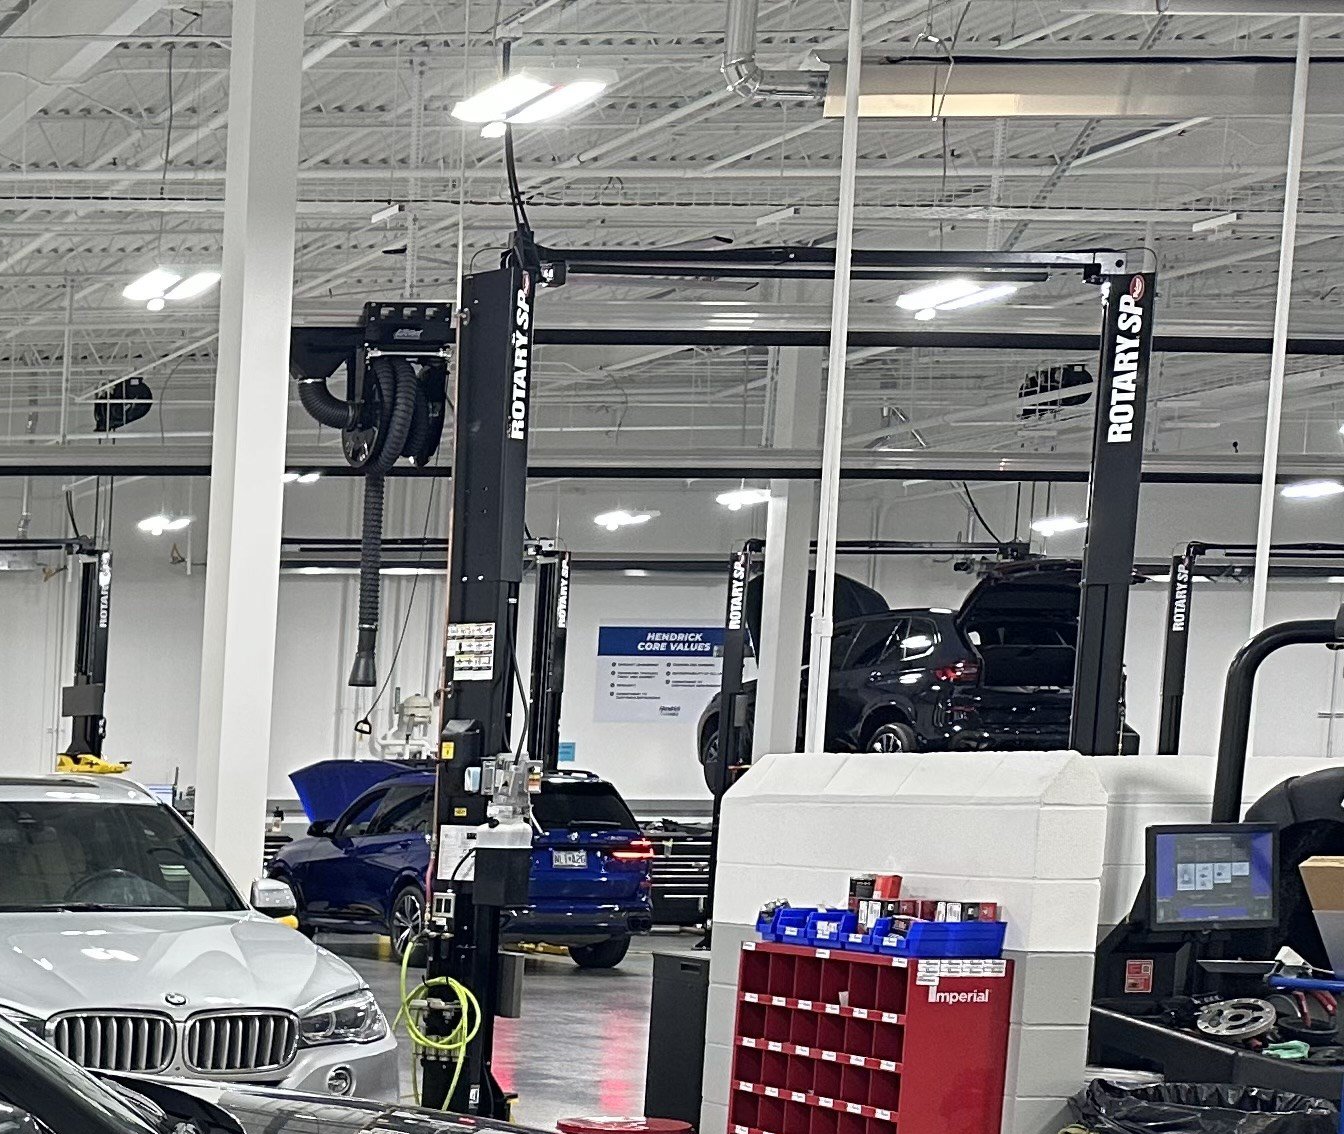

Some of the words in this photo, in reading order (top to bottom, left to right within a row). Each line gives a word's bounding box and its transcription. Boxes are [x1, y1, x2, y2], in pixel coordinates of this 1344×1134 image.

[516, 289, 530, 330] SP
[1118, 294, 1143, 334] SP
[511, 330, 529, 440] ROTARY
[1107, 335, 1140, 443] ROTARY
[729, 579, 744, 630] ROTARY
[1172, 583, 1188, 631] ROTARY
[637, 642, 667, 651] CORE
[670, 642, 712, 651] VALUES
[646, 632, 704, 641] HENDRICK
[928, 985, 989, 1005] Imperial
